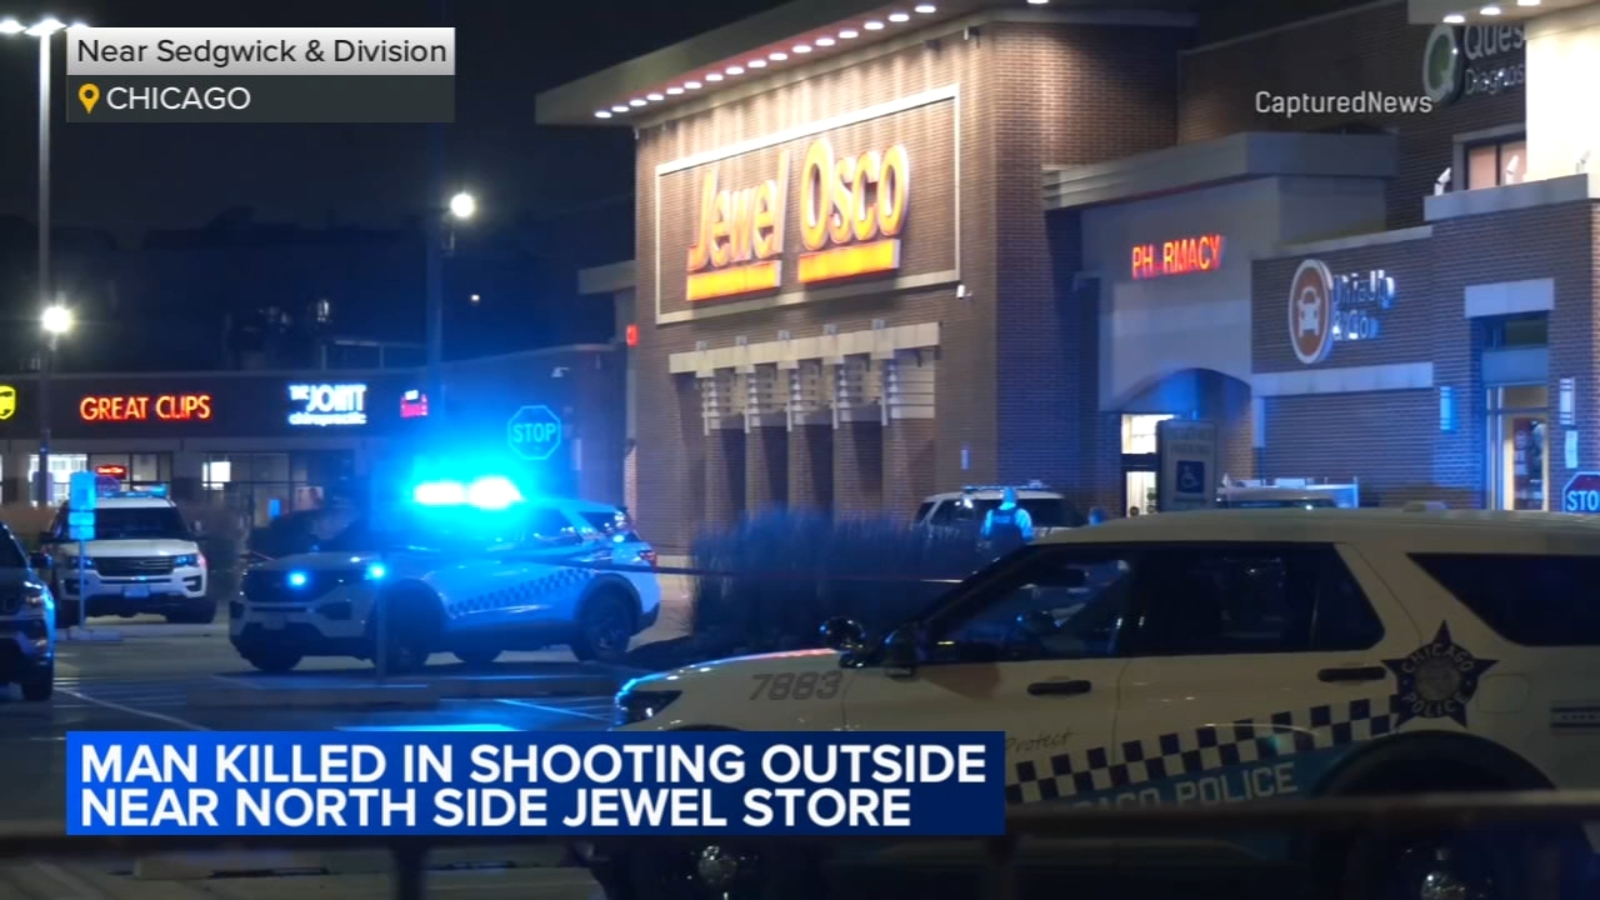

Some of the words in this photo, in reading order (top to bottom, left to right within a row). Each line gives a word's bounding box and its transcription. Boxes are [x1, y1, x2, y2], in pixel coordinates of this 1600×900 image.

[687, 150, 790, 271] Jewel
[800, 137, 909, 251] Osco
[1132, 234, 1222, 279] PHRMACY
[80, 397, 149, 421] GREAT
[156, 395, 211, 419] CLIPS
[306, 384, 367, 412] JOINT
[513, 422, 556, 443] STOP
[1401, 643, 1474, 674] CHICAGO
[749, 670, 842, 701] 7883
[1401, 690, 1469, 717] POLICE
[1176, 761, 1299, 806] POLICE
